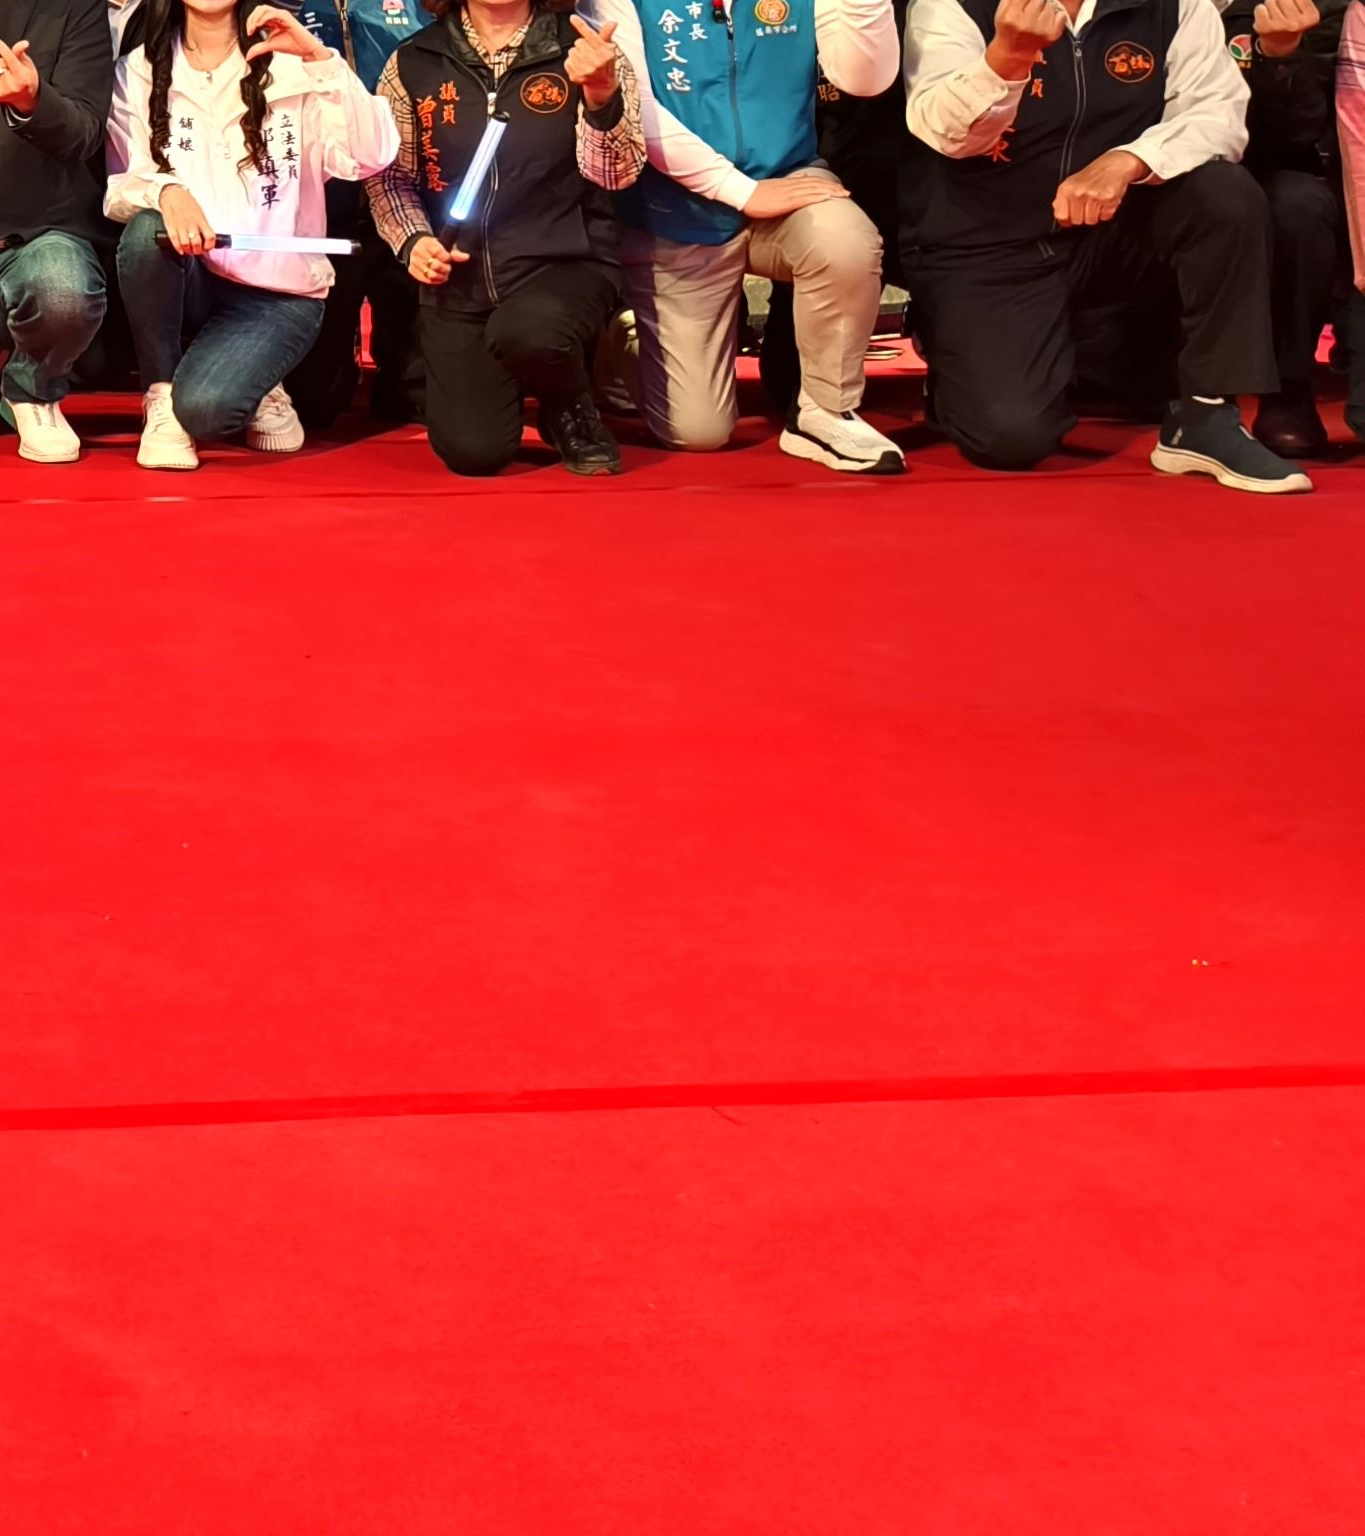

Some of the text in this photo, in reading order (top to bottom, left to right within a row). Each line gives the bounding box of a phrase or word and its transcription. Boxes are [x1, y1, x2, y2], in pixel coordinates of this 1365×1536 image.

[685, 1, 708, 41] 市長
[657, 8, 692, 92] 余文忠
[439, 80, 461, 125] 議員
[279, 113, 299, 180] 立法委員
